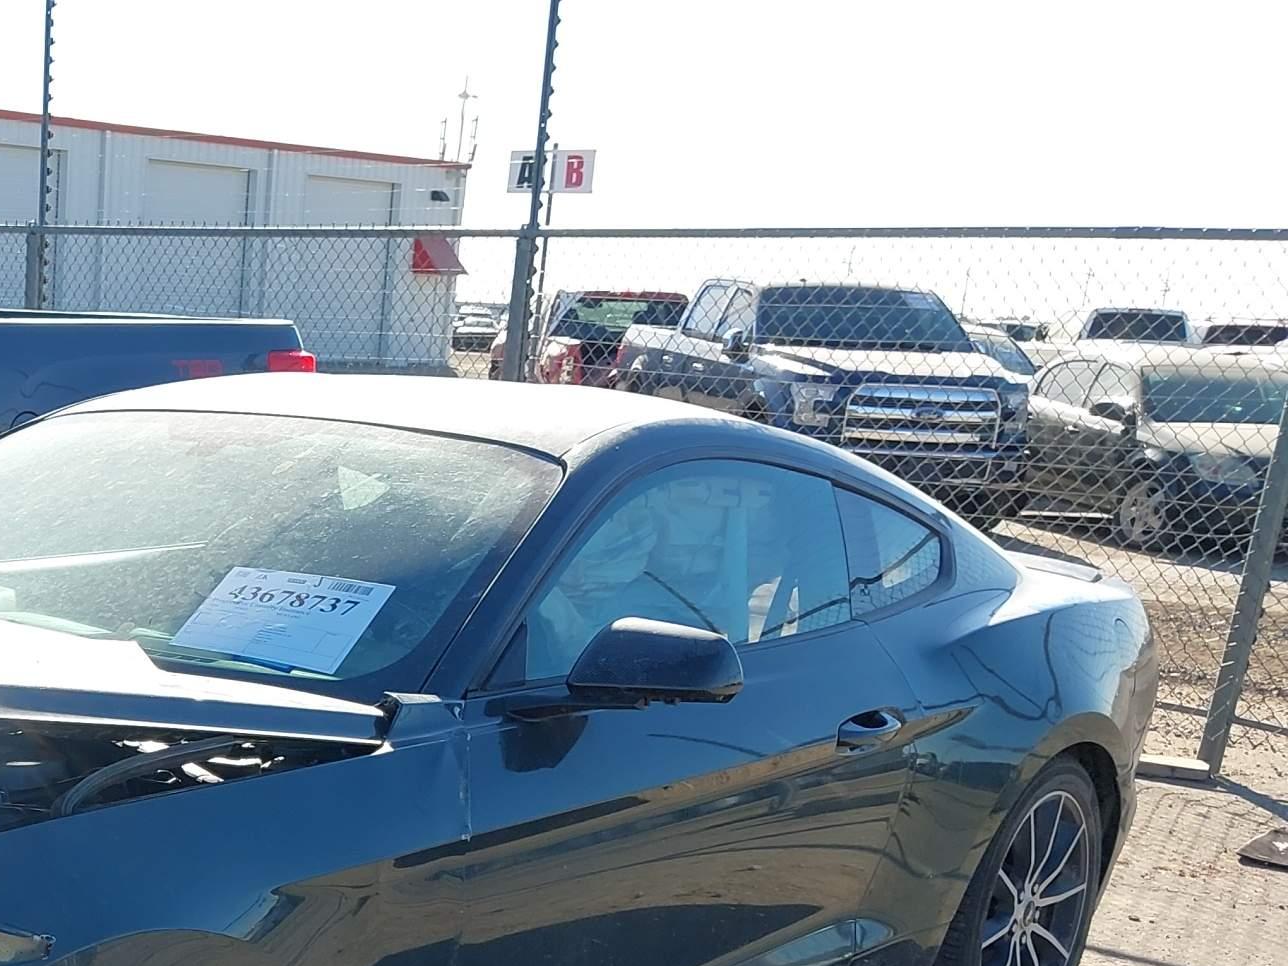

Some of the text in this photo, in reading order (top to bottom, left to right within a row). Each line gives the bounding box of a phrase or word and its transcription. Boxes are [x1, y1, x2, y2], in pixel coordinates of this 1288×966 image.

[515, 155, 584, 188] A B
[228, 584, 361, 616] 43678737
